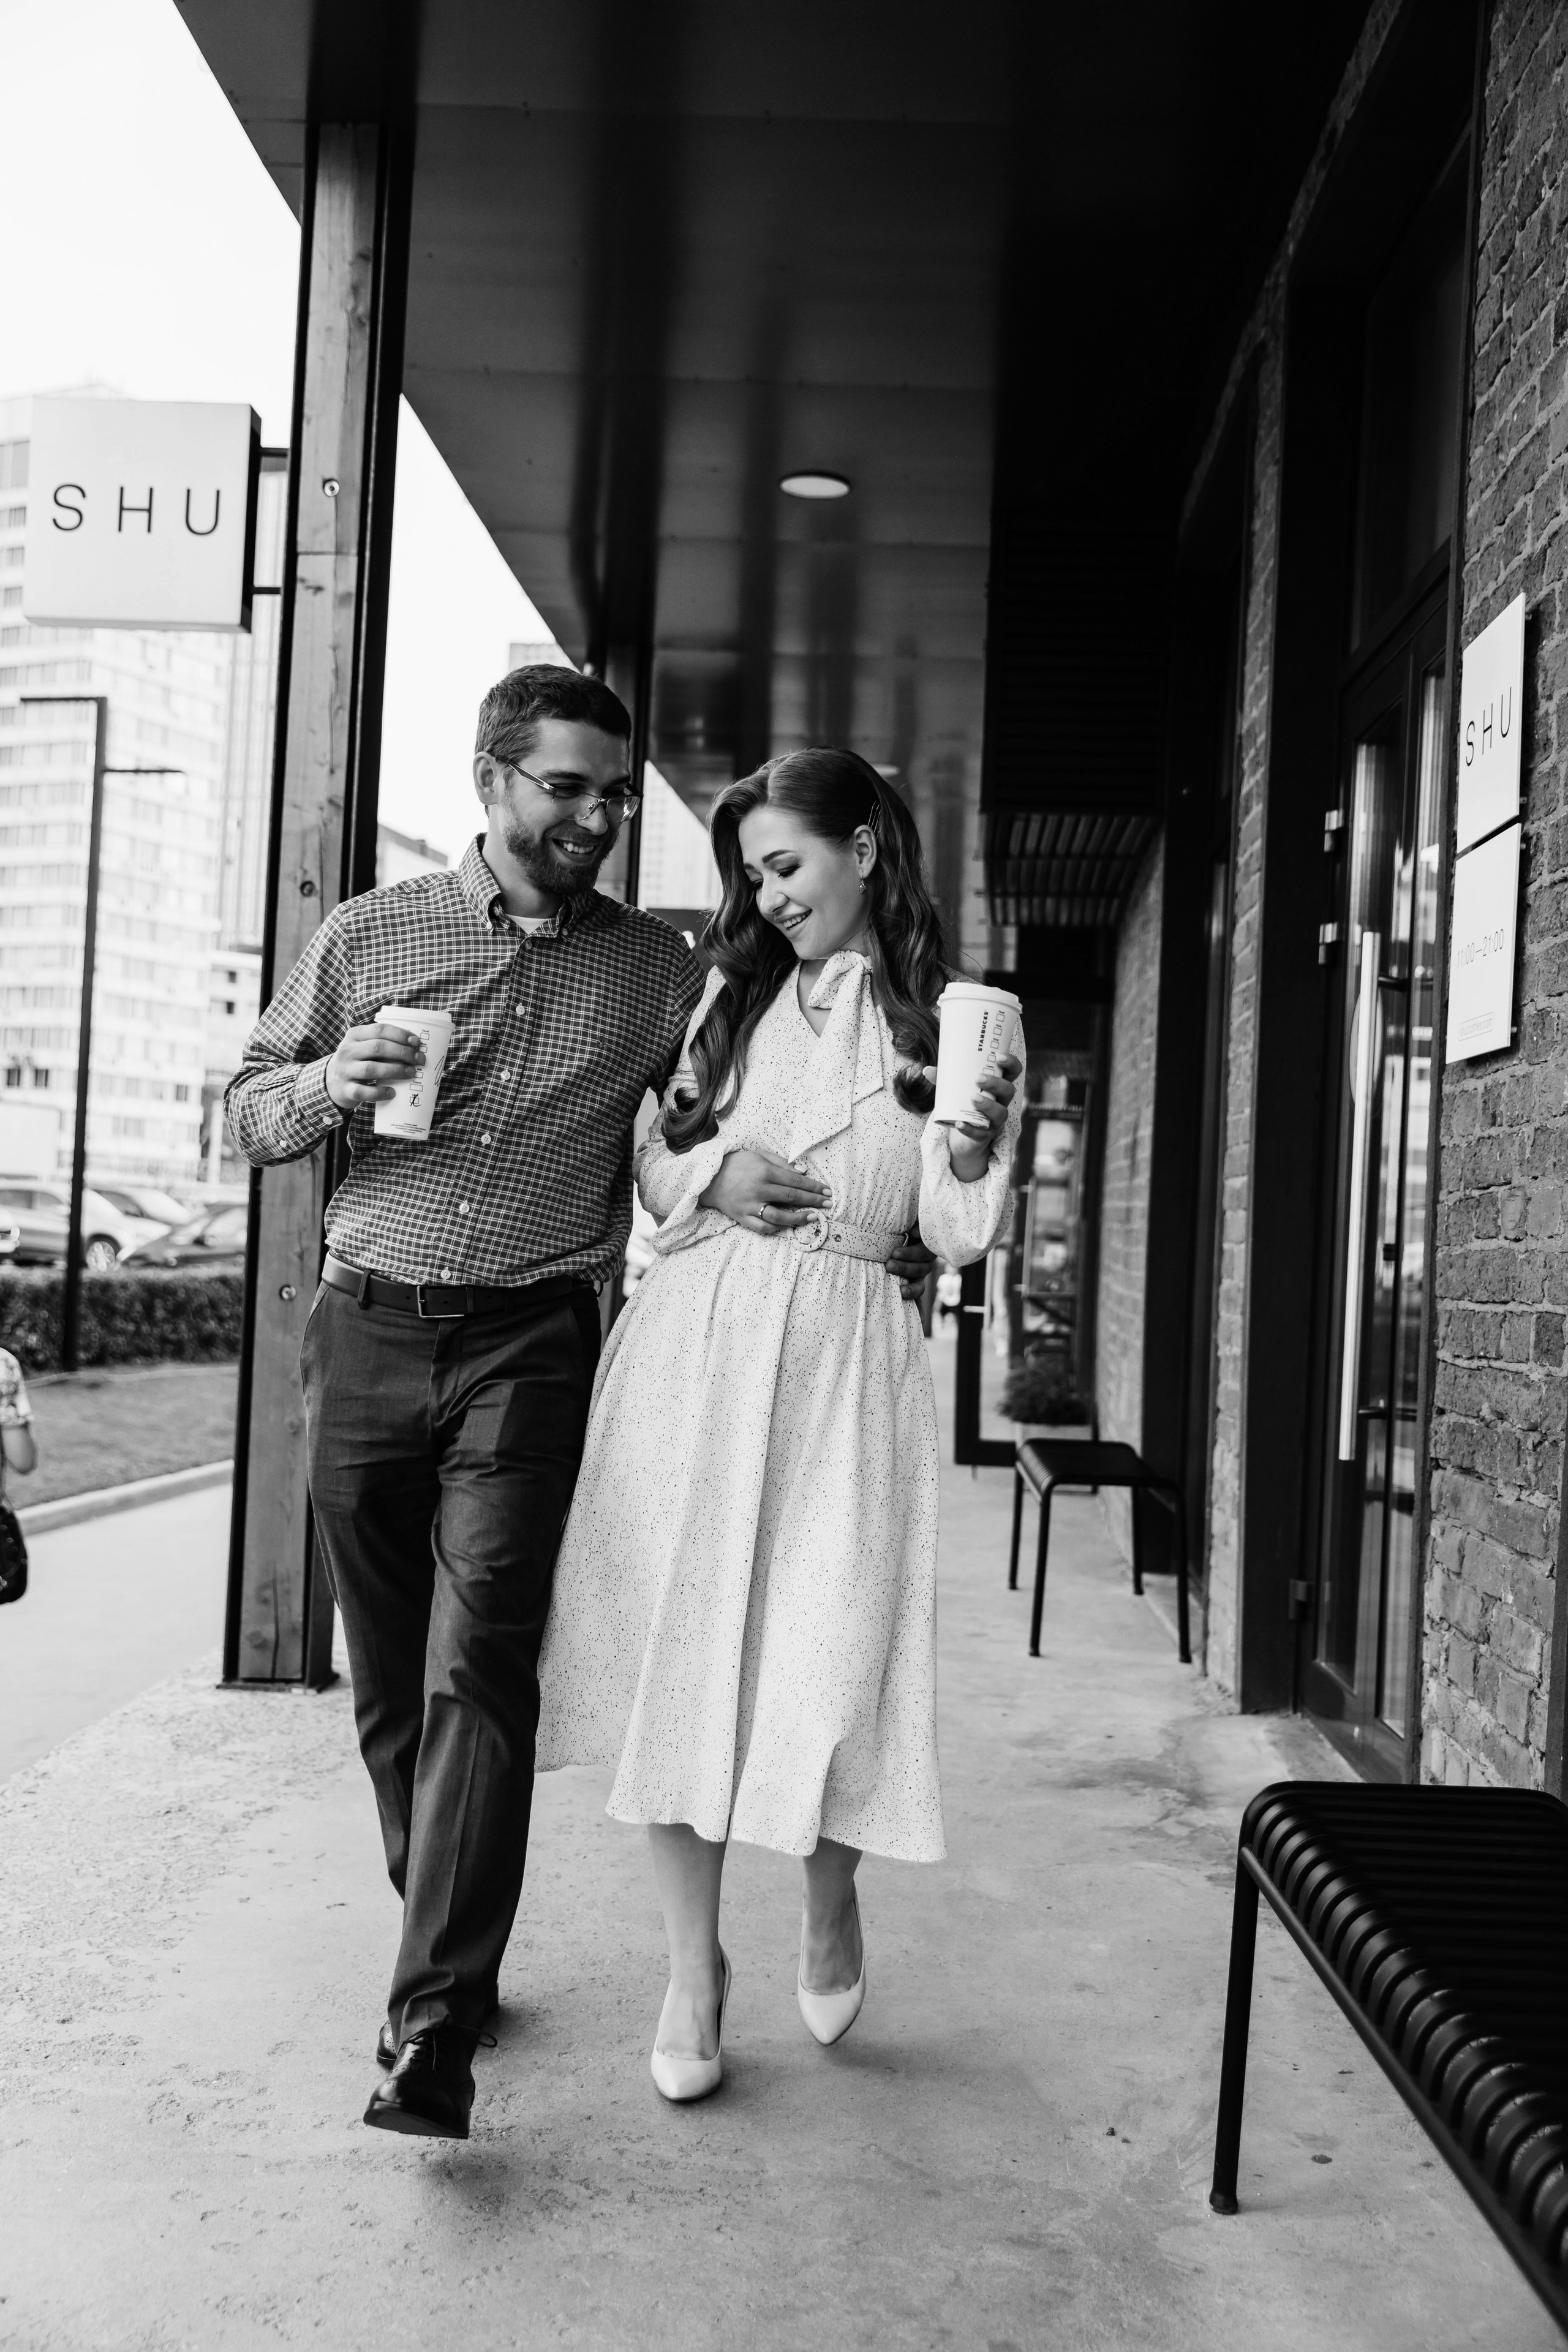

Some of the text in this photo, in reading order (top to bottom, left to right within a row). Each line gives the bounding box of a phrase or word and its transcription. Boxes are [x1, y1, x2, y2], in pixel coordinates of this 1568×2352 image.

[52, 484, 221, 536] SHU
[1466, 686, 1512, 767] SHU
[978, 1011, 989, 1052] STARBUCKS
